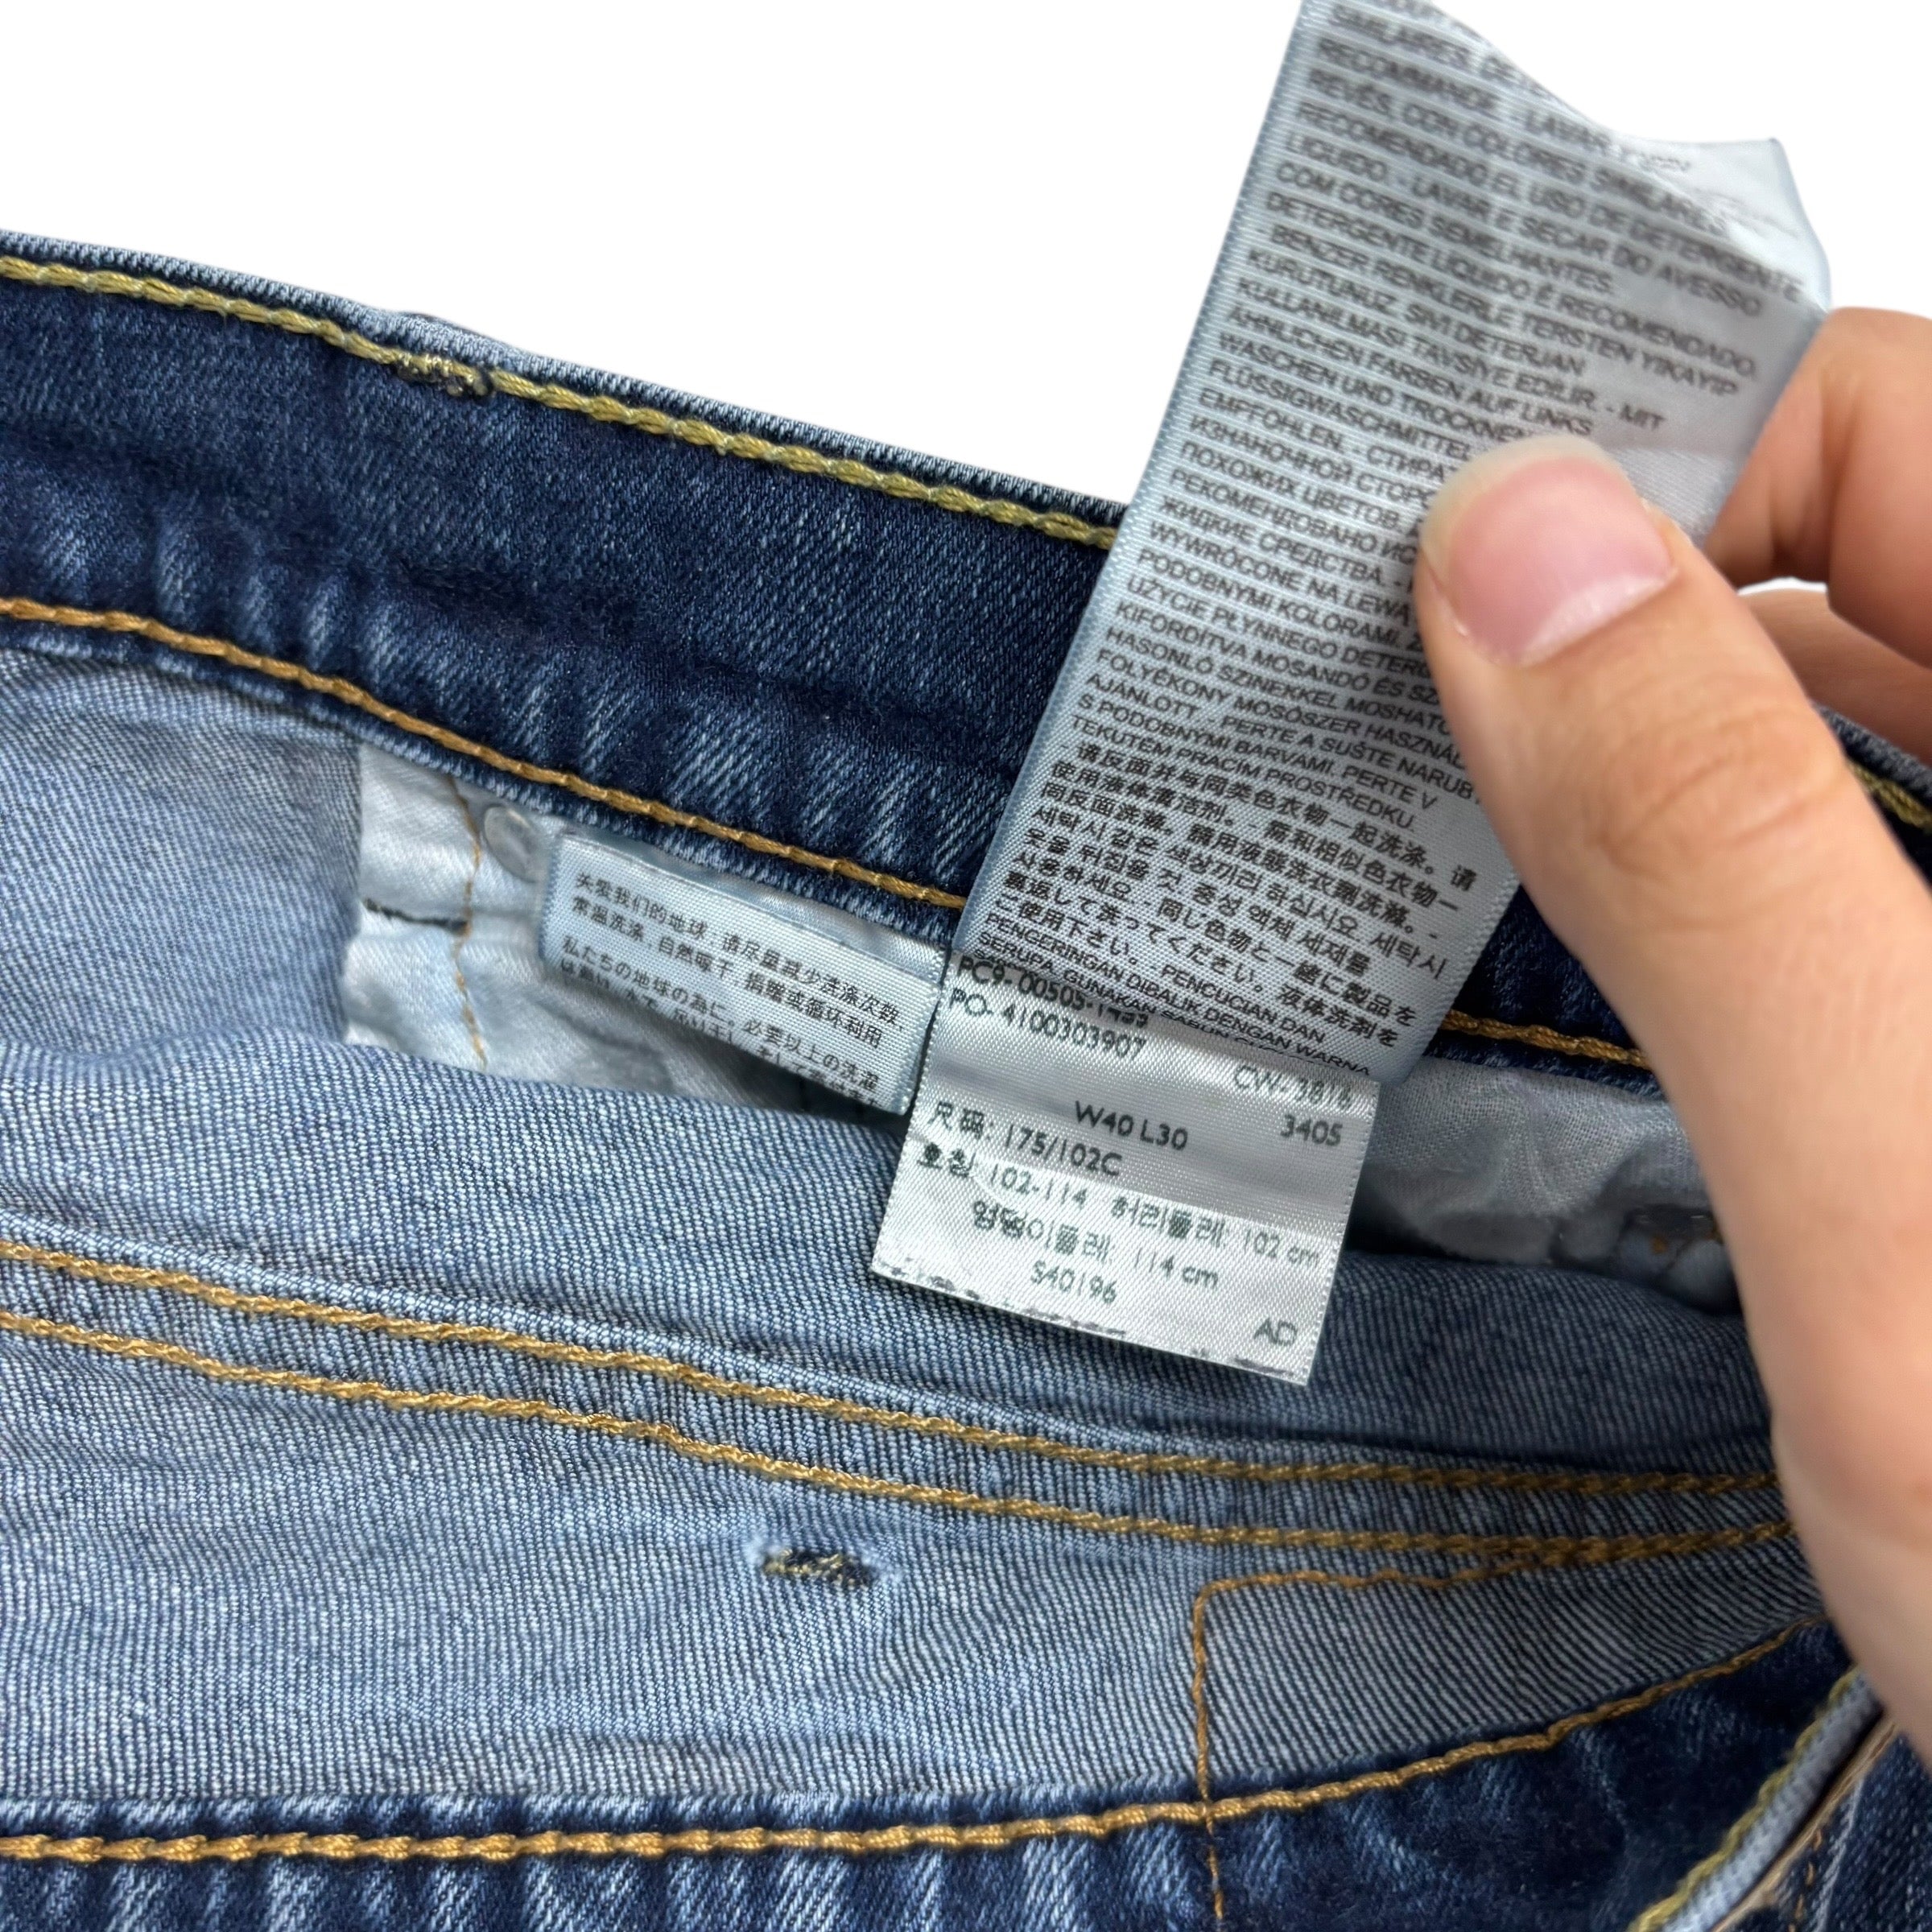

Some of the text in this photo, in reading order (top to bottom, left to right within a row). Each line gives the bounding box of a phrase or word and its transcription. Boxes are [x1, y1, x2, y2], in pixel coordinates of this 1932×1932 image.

[1294, 99, 1491, 188] RECOMENDADO
[1491, 167, 1527, 200] EL
[1526, 180, 1585, 220] USO
[1587, 202, 1627, 234] DE
[1401, 101, 1461, 141] CON
[1459, 120, 1587, 186] COLORES
[1265, 190, 1435, 266] DETERGENTE
[1275, 159, 1335, 196] COM
[1336, 181, 1426, 230] CORES
[1409, 174, 1494, 222] LAVAR
[1493, 204, 1520, 233] E
[1518, 213, 1609, 262] SECAR
[1609, 244, 1652, 278] DO
[1654, 262, 1765, 319] AVESSO
[1270, 225, 1371, 274] BENZER
[1371, 258, 1517, 328] RENKLERLE
[1520, 312, 1636, 365] TERSTEN
[1216, 331, 1339, 389] WASCHEN
[1338, 373, 1396, 408] UND
[1236, 276, 1408, 350] KULLANILMASI
[1616, 402, 1664, 433] MIT
[1452, 320, 1587, 377] DETERJAN
[1365, 350, 1465, 401] FARBEN
[1464, 383, 1522, 420] AUF
[1519, 402, 1595, 439] LINKS
[1179, 440, 1301, 499] ПОХОЖИХ
[1189, 413, 1356, 485] ИЗНАНОЧНОЙ
[1158, 495, 1257, 547] ЖИДКИЕ
[1168, 467, 1379, 555] РЕКОМЕНДОВАНО
[1137, 548, 1274, 612] PODOBNYMI
[1147, 521, 1305, 592] WYWRÓCONE
[1305, 578, 1342, 605] NA
[1114, 600, 1250, 662] KIFORDÍTVA
[1251, 648, 1372, 693] MOSANDÓ
[1211, 606, 1339, 662] PŁYNNEGO
[1095, 647, 1231, 708] FOLYÉKONY
[1232, 692, 1362, 739] MOSÓSZER
[1076, 691, 1095, 711] S
[1233, 739, 1337, 777] BARVAMI.
[1342, 764, 1418, 805] PERTE
[1416, 791, 1438, 813] V
[1174, 745, 1264, 781] PRACÍM
[1219, 713, 1298, 746] PERTE
[1296, 730, 1317, 750] A
[1319, 734, 1396, 770] SUŠTE
[1396, 756, 1484, 805] NARUB
[1061, 967, 1156, 1015] GUNAKAN
[1367, 929, 1447, 980] 세탁시
[985, 912, 1124, 983] PENGERINGAN
[1125, 971, 1202, 1017] DIBALIK
[1202, 1005, 1292, 1051] DENGAN
[1294, 1042, 1373, 1077] WARNA
[1000, 1000, 1148, 1062] 4100303907
[1159, 963, 1278, 1025] PENCUCIAN
[1279, 1015, 1327, 1045] DAN
[1003, 1122, 1125, 1179] 175/102C
[1070, 1100, 1191, 1153] W40 L30
[1278, 1110, 1344, 1151] 3405
[988, 1161, 1090, 1210] 102-114
[1241, 1227, 1283, 1260] 102
[1284, 1243, 1322, 1270] cm
[1133, 1245, 1178, 1280] 114
[1179, 1262, 1221, 1292] cm
[1252, 1314, 1301, 1351] AD
